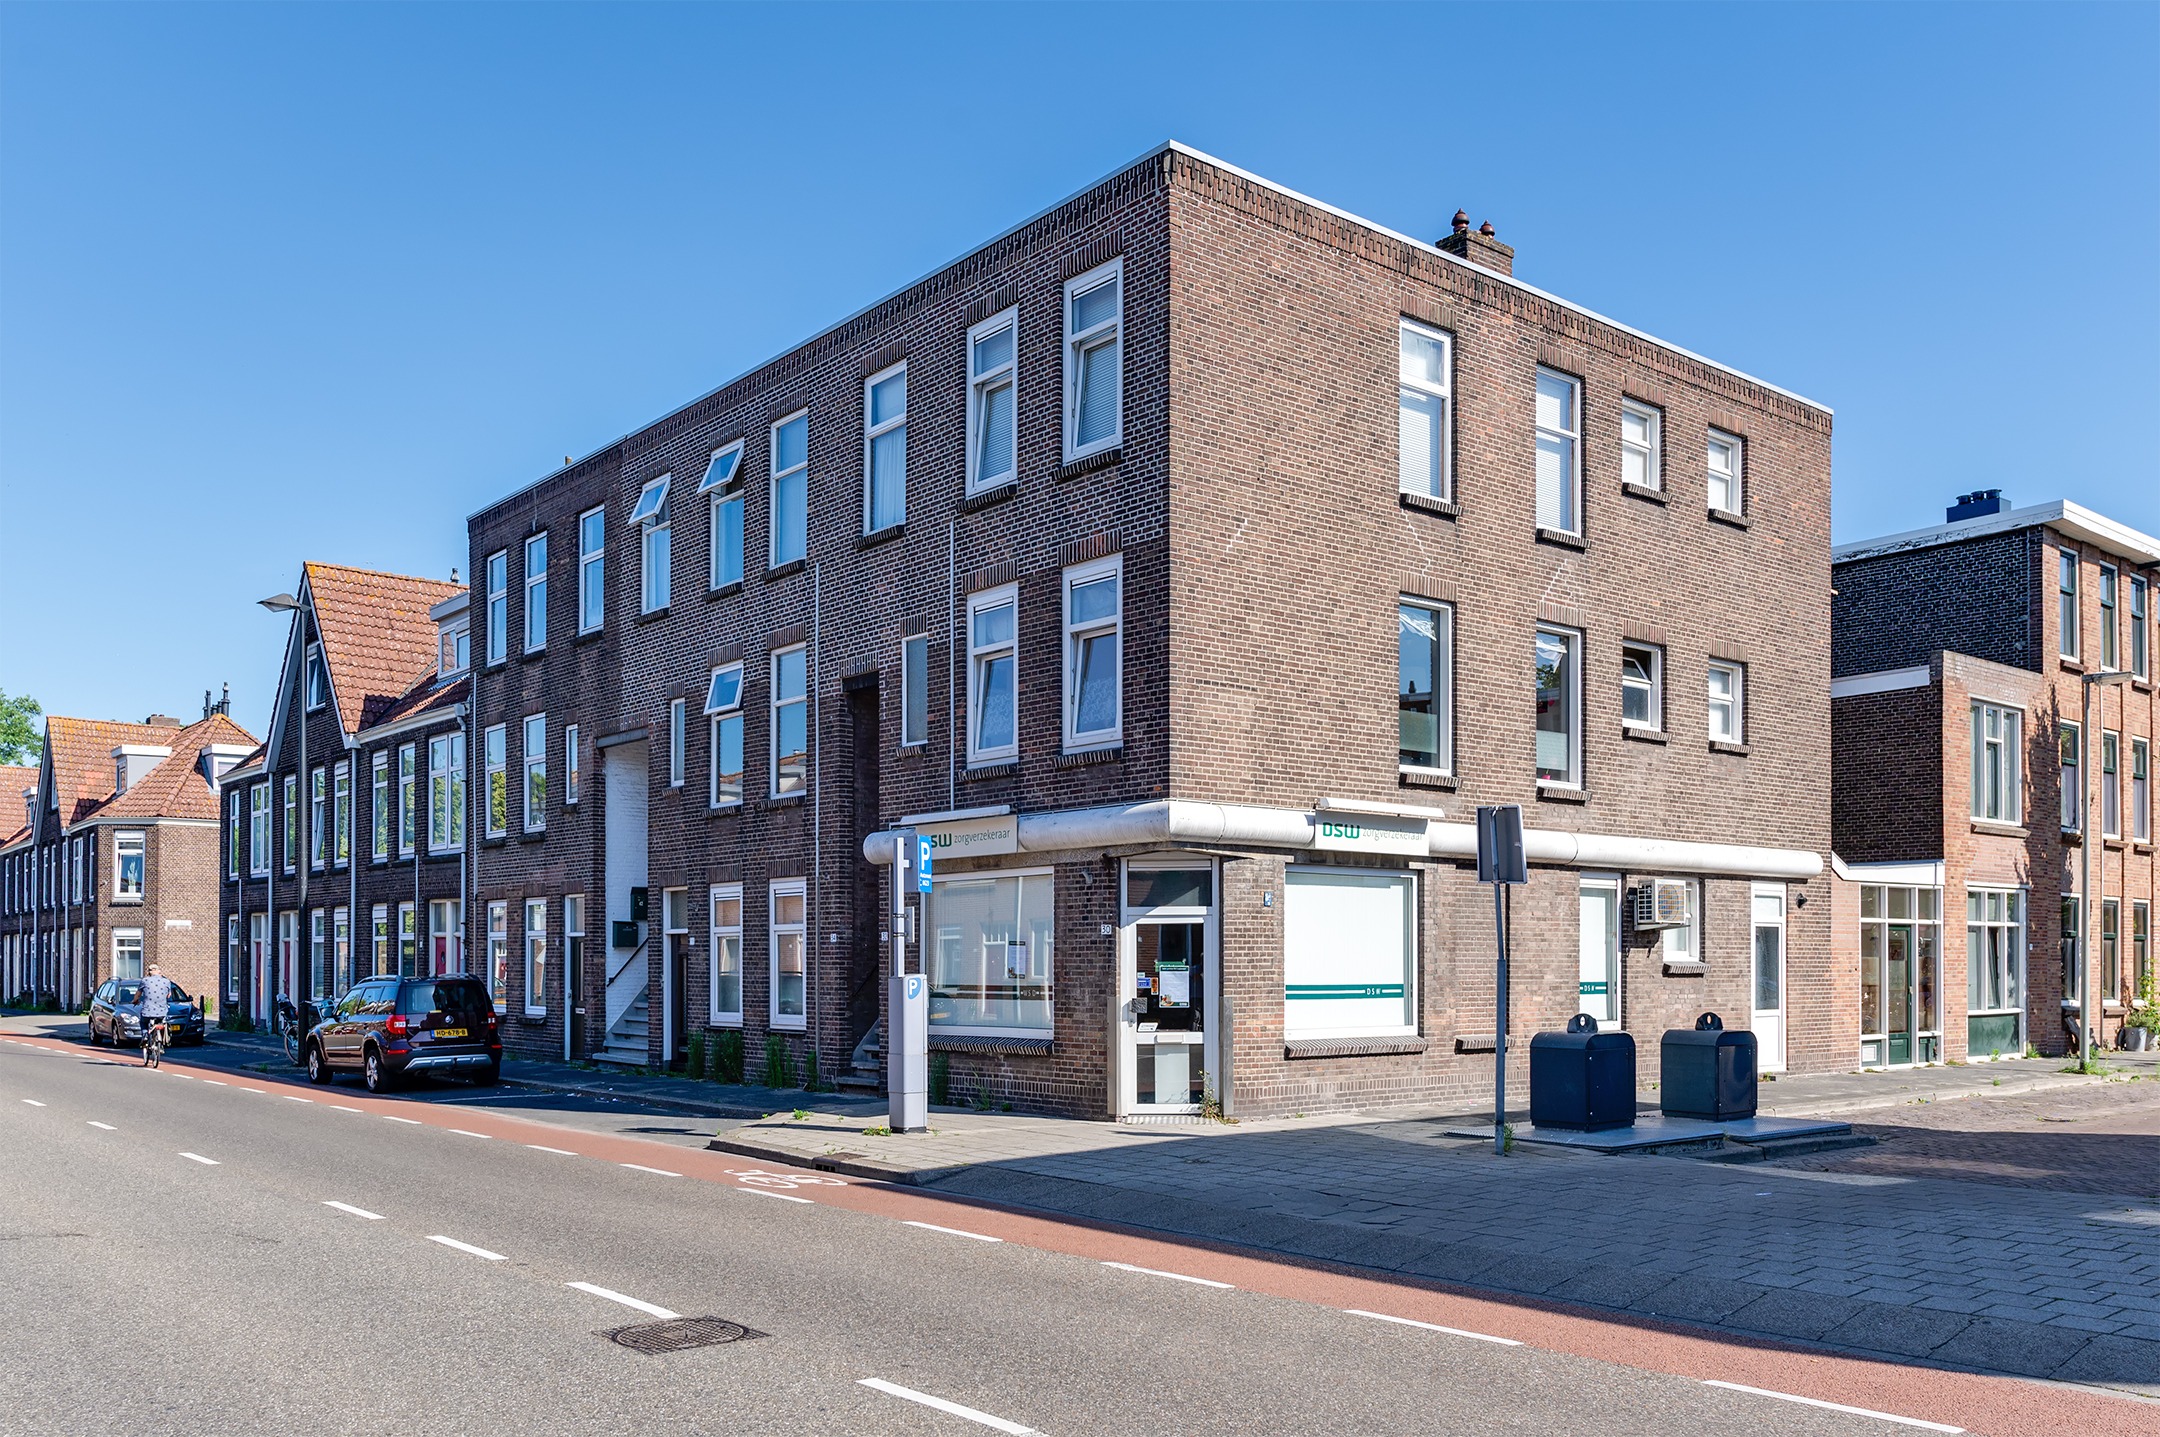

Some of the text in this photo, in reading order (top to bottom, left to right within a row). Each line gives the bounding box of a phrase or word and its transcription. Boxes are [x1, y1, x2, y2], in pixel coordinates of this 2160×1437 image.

[930, 829, 1011, 848] SW zorgverzekeraar
[1322, 822, 1361, 839] DSW
[921, 841, 931, 871] P
[1101, 925, 1111, 934] 30
[909, 979, 918, 995] P
